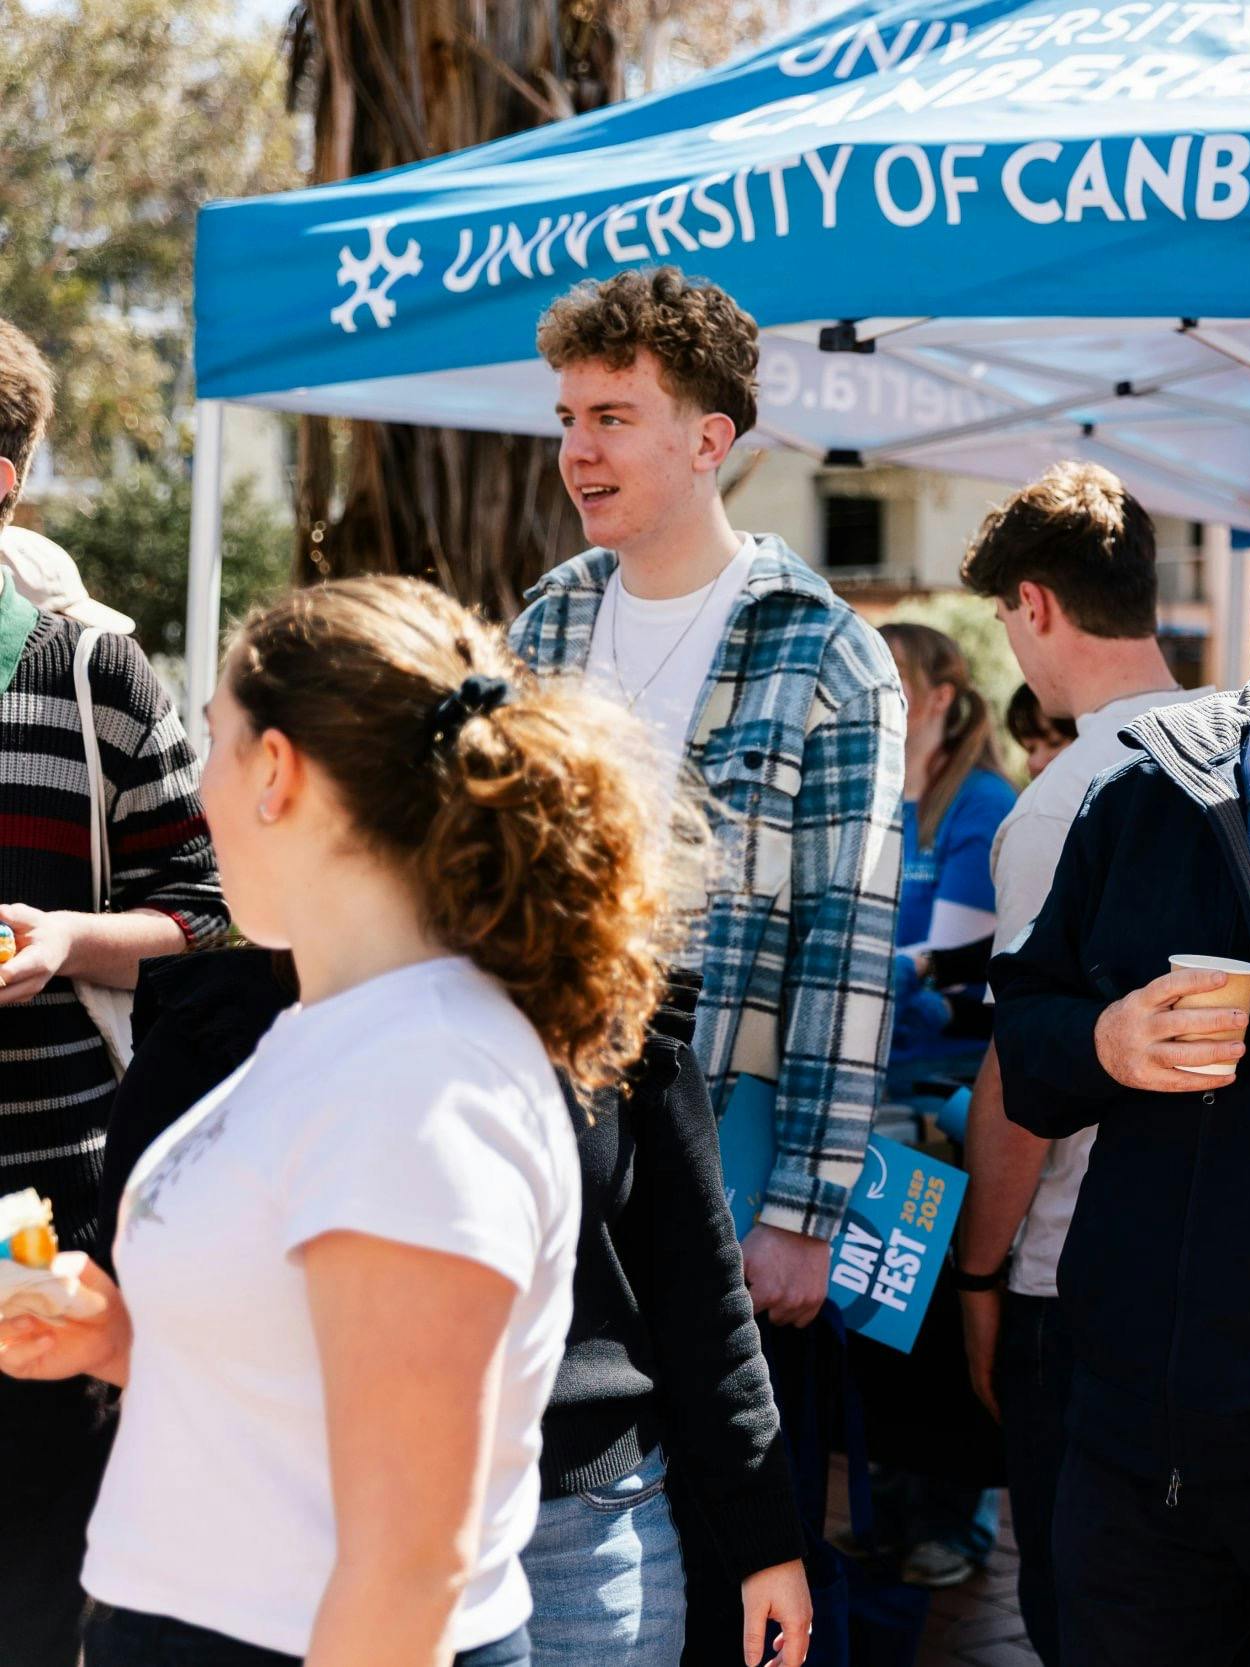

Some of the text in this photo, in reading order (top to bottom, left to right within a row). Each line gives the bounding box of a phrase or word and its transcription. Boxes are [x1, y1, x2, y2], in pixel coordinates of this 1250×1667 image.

[442, 145, 853, 293] UNIVERSITY
[873, 143, 986, 227] OF
[907, 1169, 924, 1200] SEP
[916, 1175, 946, 1232] 2025
[831, 1221, 883, 1295] DAY
[871, 1227, 927, 1312] FEST
